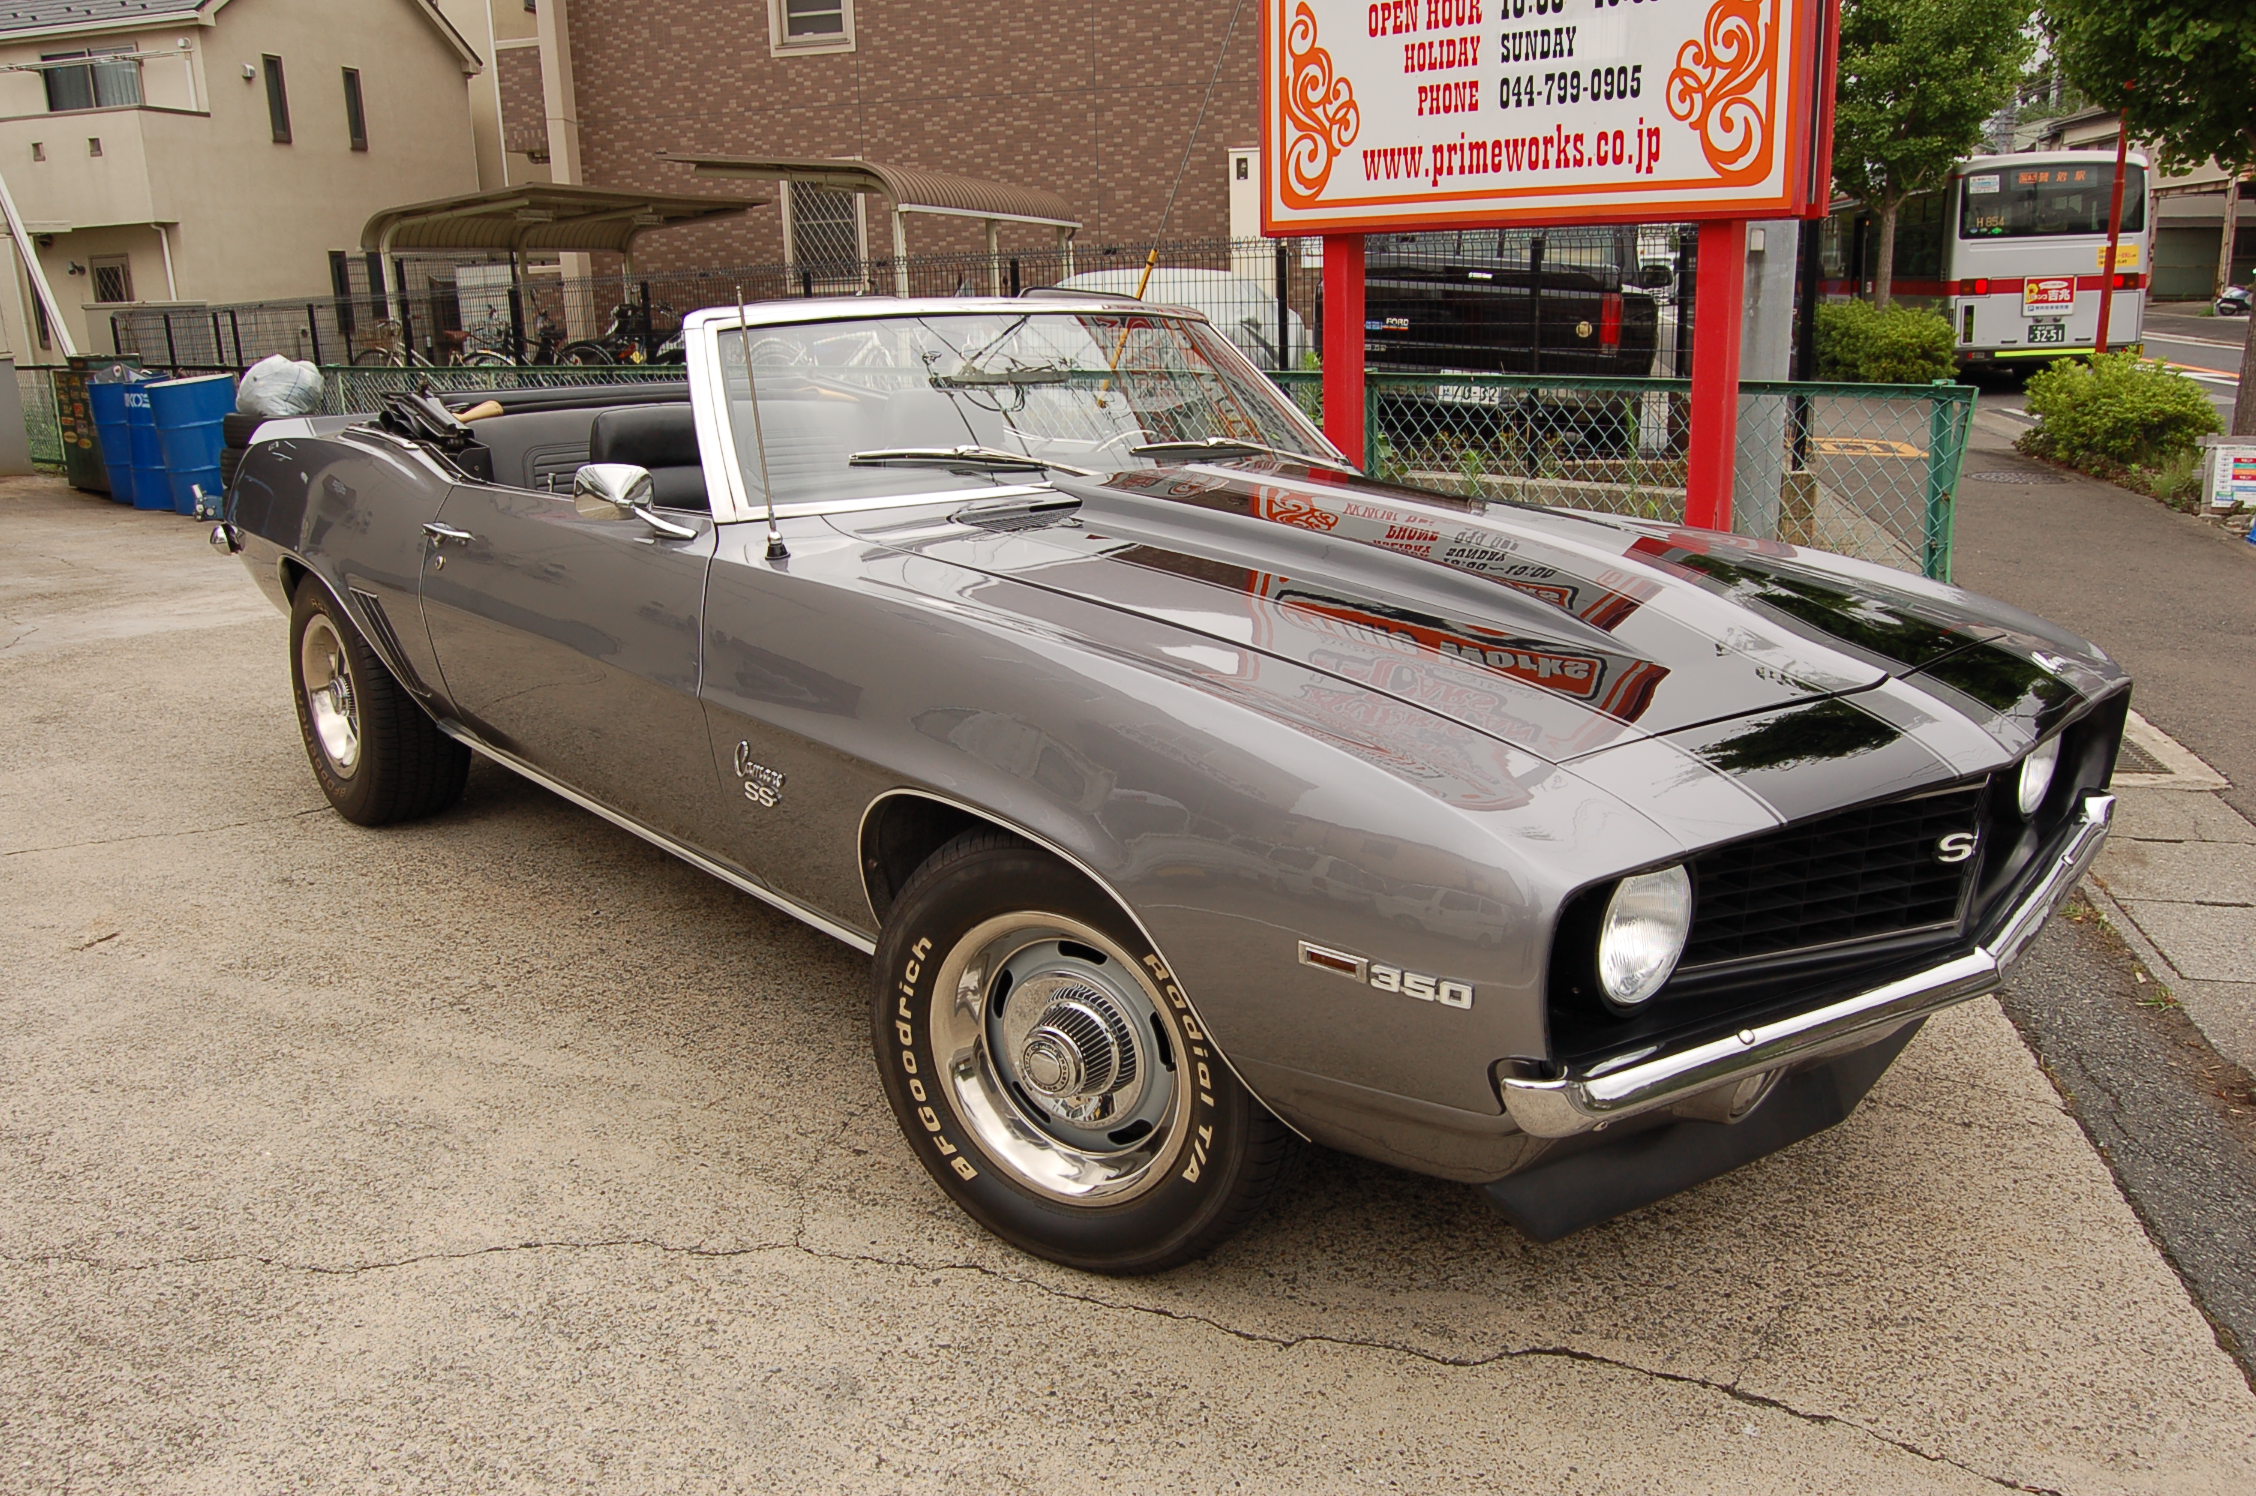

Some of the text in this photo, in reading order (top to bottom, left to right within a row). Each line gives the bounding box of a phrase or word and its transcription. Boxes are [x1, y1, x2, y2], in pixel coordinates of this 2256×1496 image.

[1368, 0, 1419, 38] OPEN
[1426, 0, 1483, 30] HOUR
[1404, 25, 1577, 74] HOLIDAY SUNDAY
[1417, 65, 1642, 117] PHONE 044-799-0905
[1362, 117, 1661, 188] www.primeworks.co.jp
[1386, 317, 1409, 326] FORD
[744, 780, 774, 808] SS
[1370, 963, 1473, 1010] 350
[895, 936, 979, 1182] BFGoodrich
[1142, 953, 1215, 1184] Radial T/A
